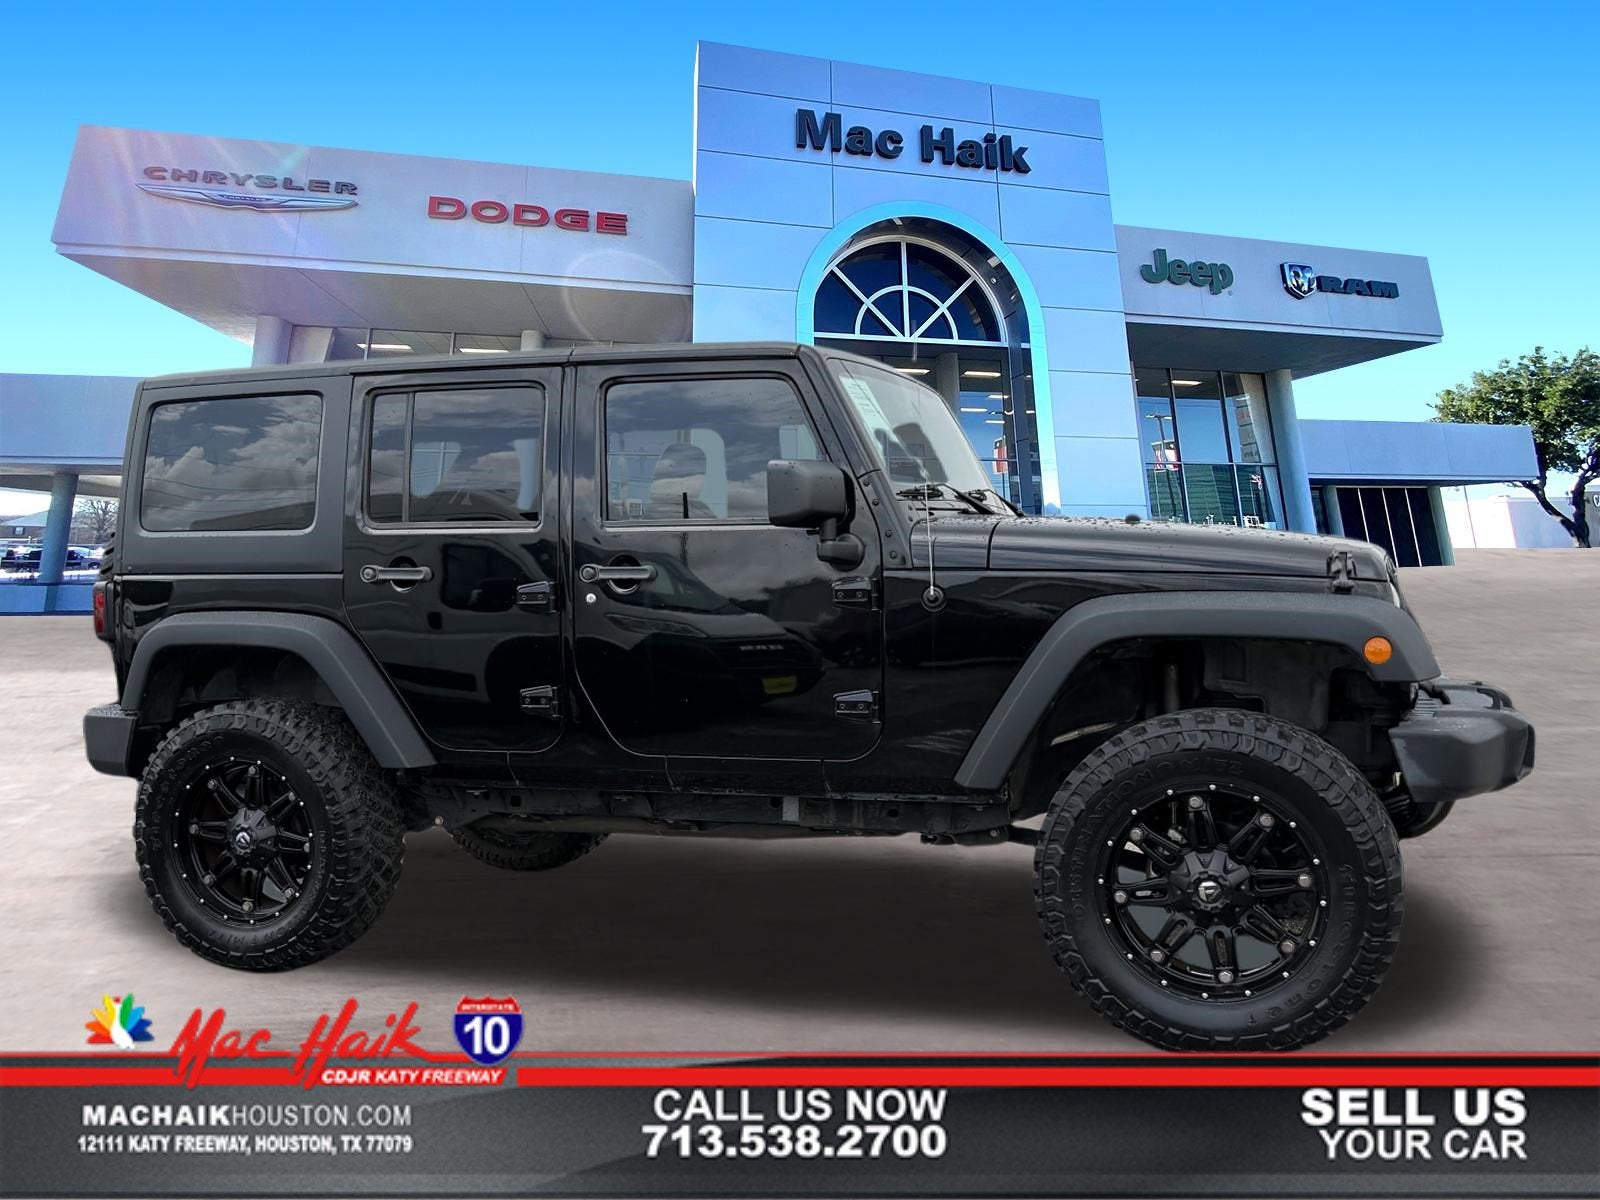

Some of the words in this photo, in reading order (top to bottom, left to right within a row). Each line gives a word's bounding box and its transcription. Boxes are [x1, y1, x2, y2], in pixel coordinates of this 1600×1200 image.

[795, 107, 904, 160] Mac
[919, 124, 1032, 174] Haik
[143, 165, 359, 196] CHRYSLER
[427, 194, 630, 236] DODGE
[1140, 248, 1234, 296] Jeep
[1315, 275, 1400, 299] RAM
